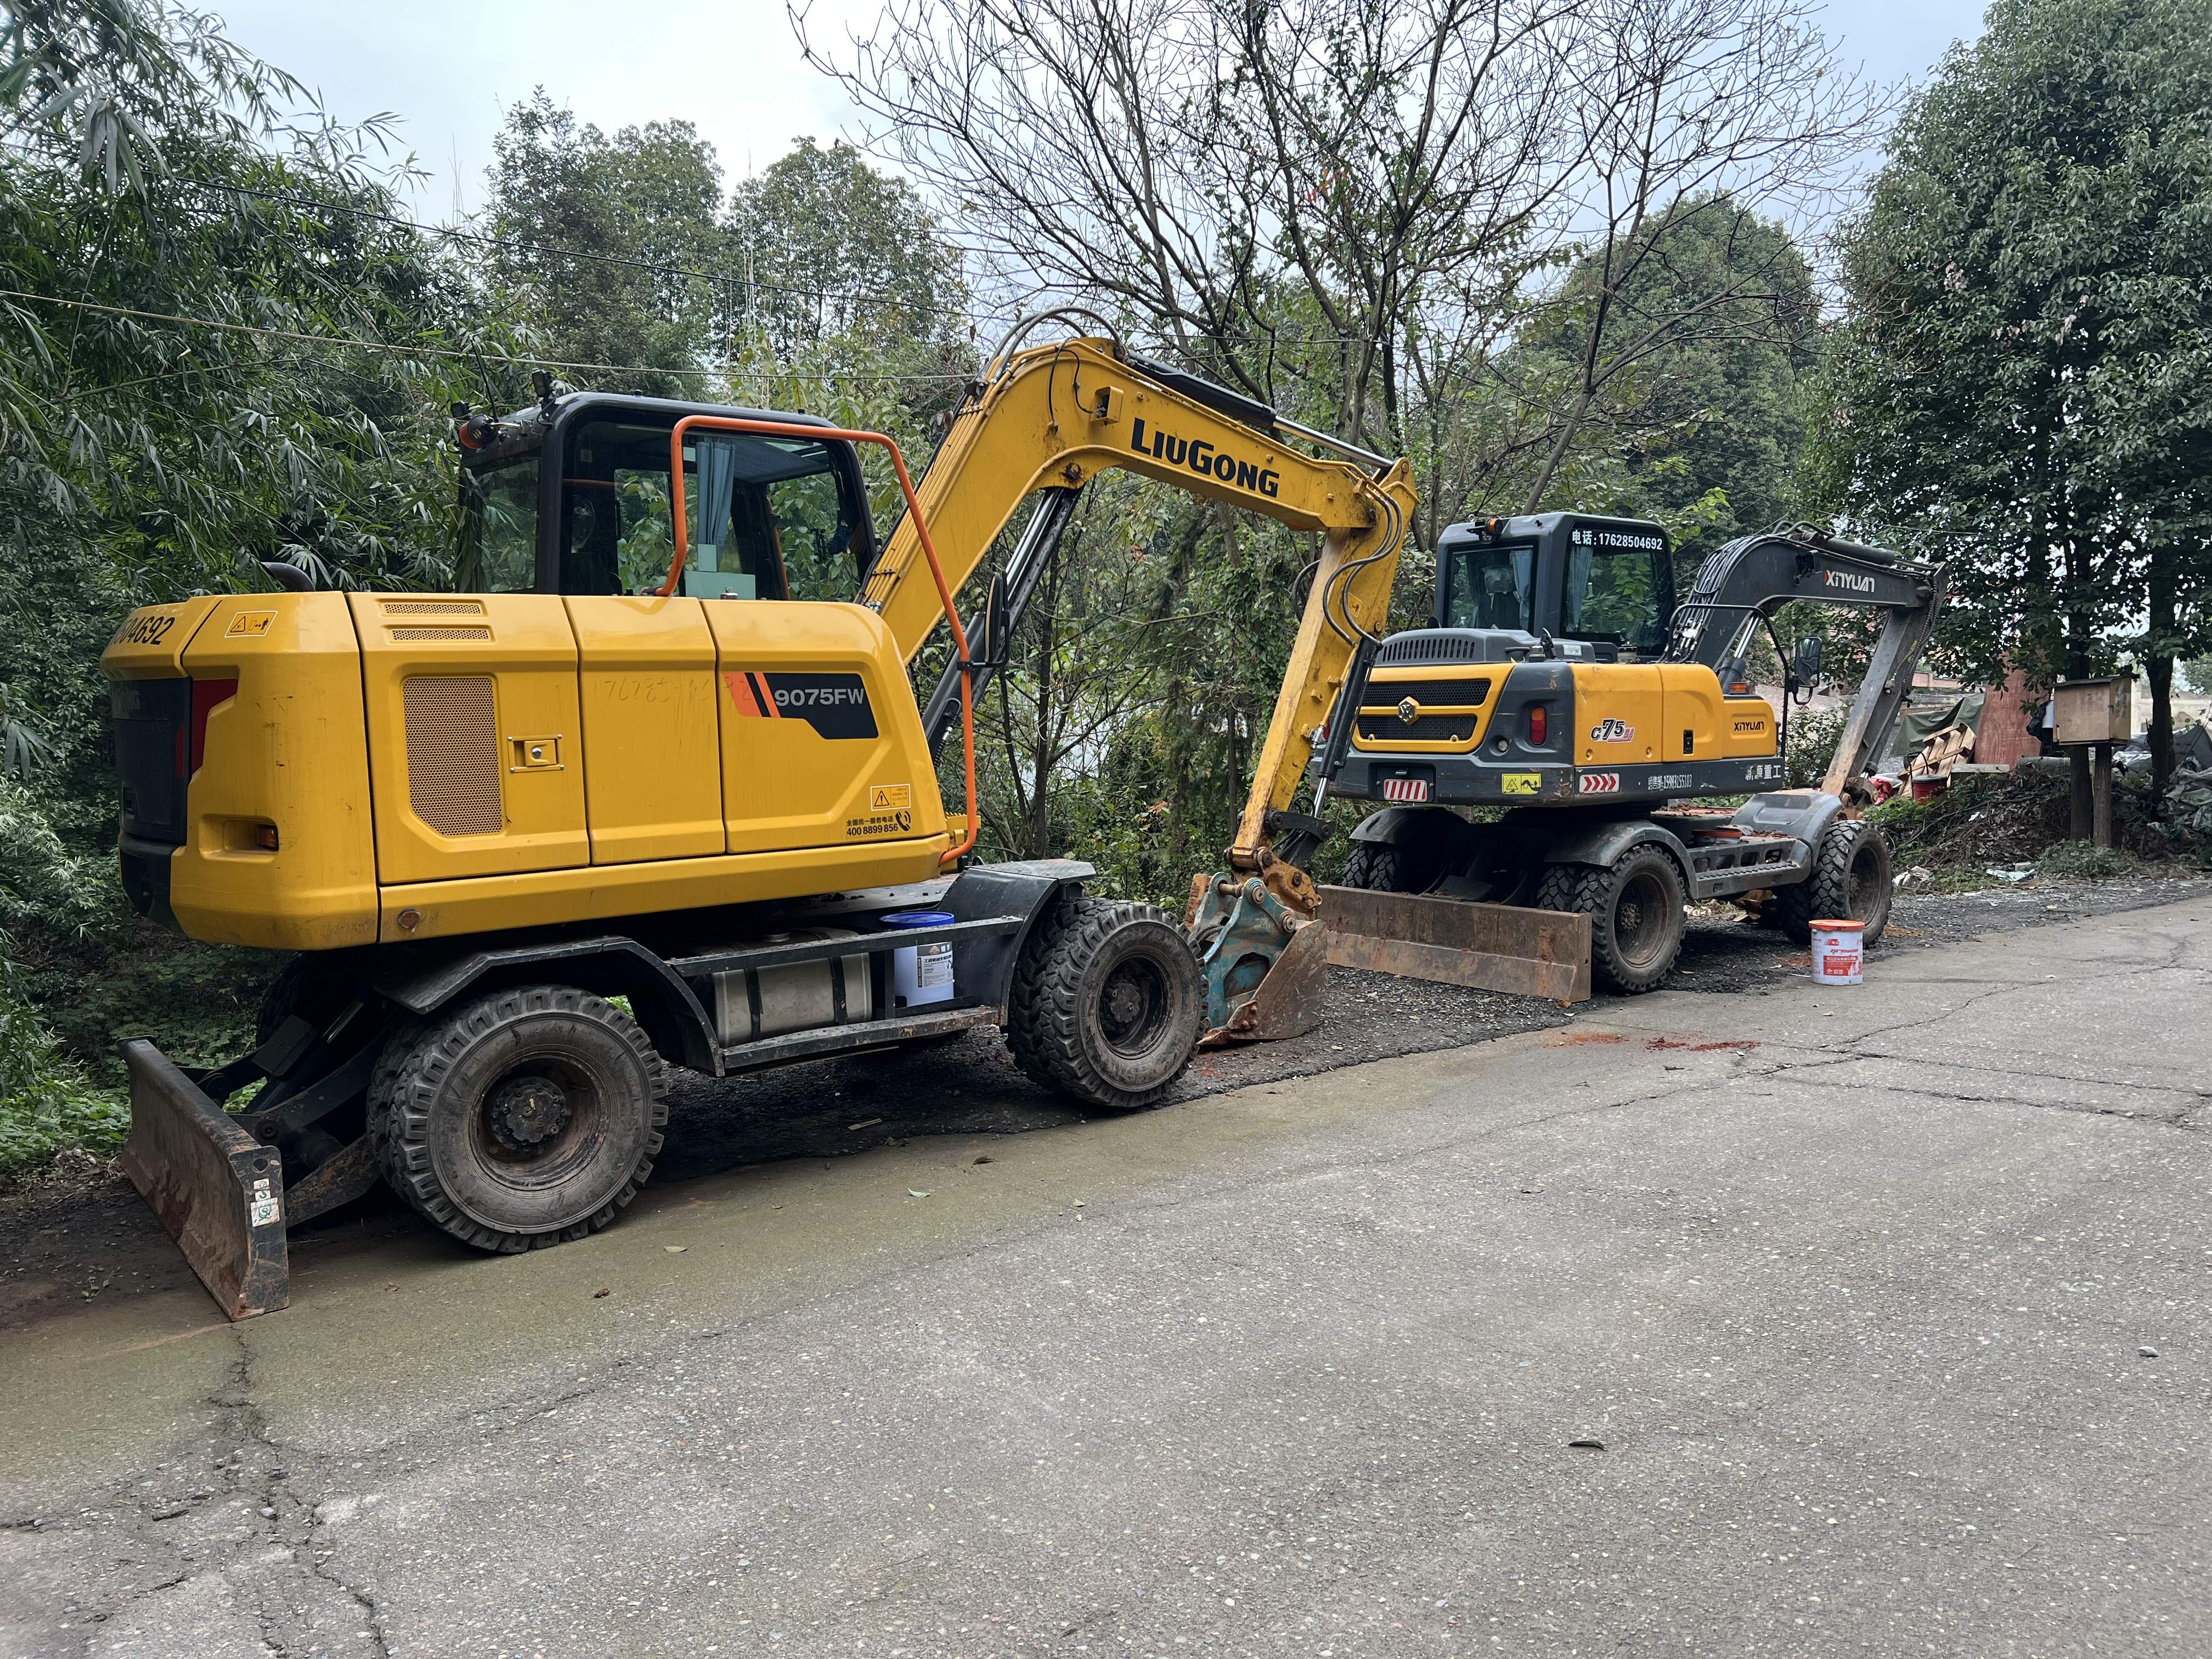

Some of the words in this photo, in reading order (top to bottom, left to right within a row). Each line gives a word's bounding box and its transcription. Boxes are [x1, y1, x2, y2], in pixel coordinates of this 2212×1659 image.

[1572, 529, 1663, 550] 电话:17628504692
[774, 689, 865, 707] 9075FW
[847, 816, 893, 827] 全国统一服务电话
[847, 827, 862, 836] 400
[863, 825, 883, 834] 8899
[884, 823, 898, 832] 856
